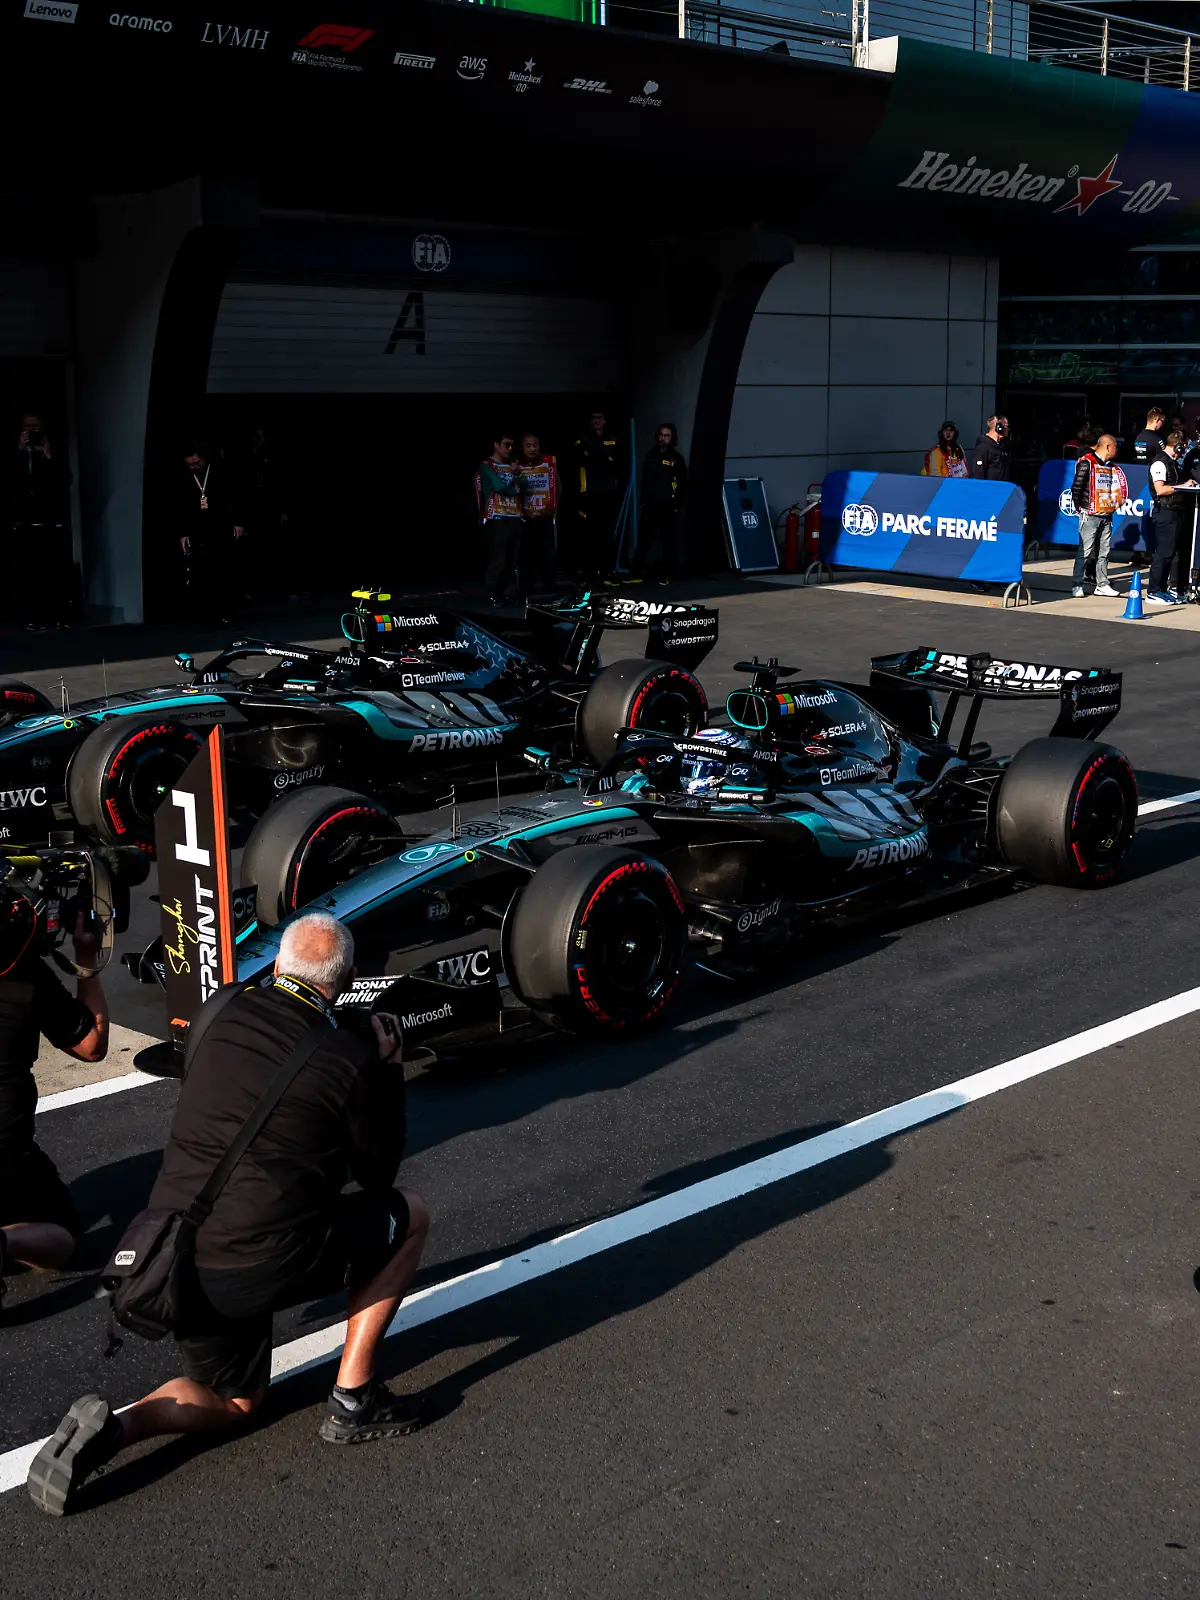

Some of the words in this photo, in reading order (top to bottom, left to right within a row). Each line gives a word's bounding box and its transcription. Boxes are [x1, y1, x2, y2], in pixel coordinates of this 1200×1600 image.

[29, 2, 73, 18] Lenovo
[109, 12, 174, 33] aramco
[200, 21, 271, 50] LVMH
[393, 52, 437, 69] PIRELLI
[459, 55, 488, 71] aws
[507, 71, 542, 84] Heineken
[571, 77, 608, 93] DHL
[629, 95, 663, 108] salesforce
[897, 150, 1065, 204] Heineken
[384, 291, 426, 355] A
[881, 512, 932, 536] PARC
[936, 515, 998, 542] FERMÉ
[393, 614, 439, 628] Microsoft
[673, 616, 717, 629] Snapdragon
[427, 640, 465, 652] SOLERA
[266, 648, 309, 661] CROWDSTRIKE
[334, 654, 352, 663] AMD
[413, 671, 466, 685] TeamViewer
[1080, 681, 1120, 696] Snapdragon
[794, 690, 838, 709] Microsoft
[185, 709, 226, 720] AMG
[827, 722, 862, 738] SOLERA
[408, 727, 504, 753] PETRONAS
[677, 743, 728, 757] CROWDSTRIKE
[171, 787, 211, 868] 1
[595, 826, 639, 840] AMG
[846, 831, 929, 872] PETRONAS
[162, 897, 200, 975] Shanghai
[436, 950, 491, 979] IWC
[274, 976, 300, 993] ikon
[351, 980, 395, 990] RONAS
[334, 988, 382, 1006] yntiu
[401, 1003, 453, 1029] Microsoft
